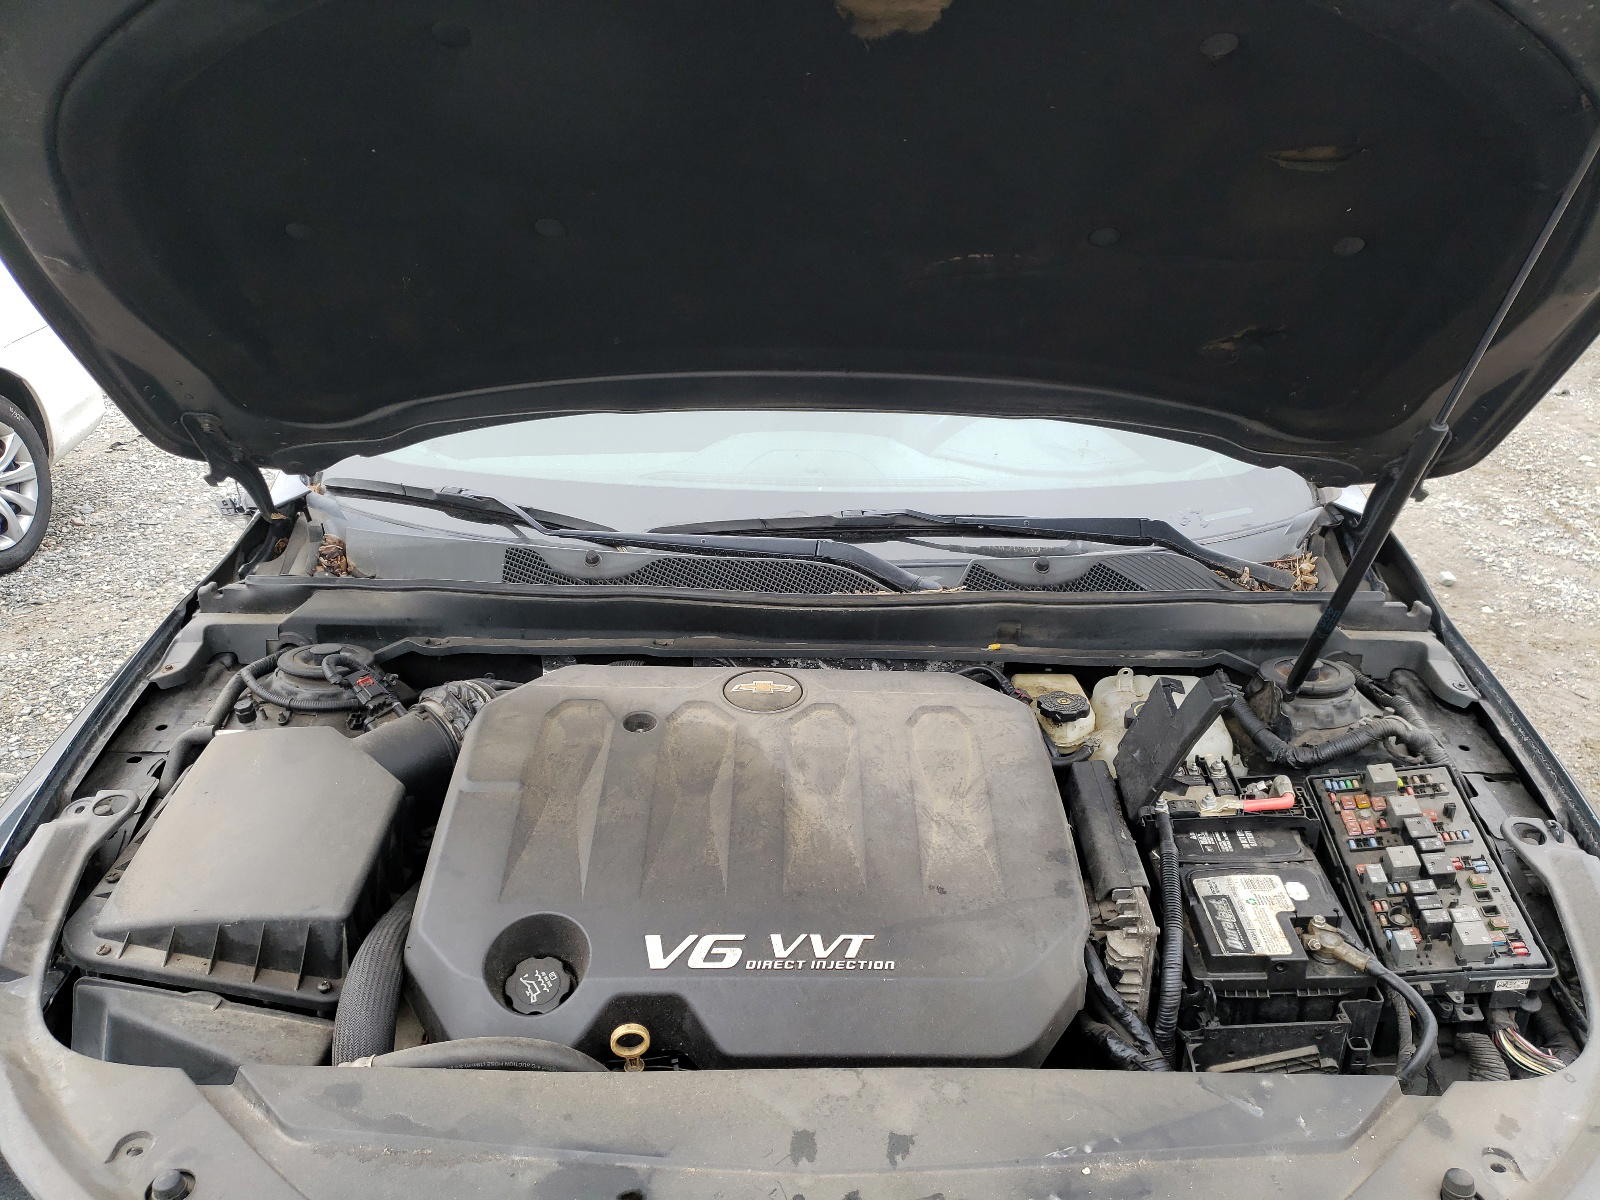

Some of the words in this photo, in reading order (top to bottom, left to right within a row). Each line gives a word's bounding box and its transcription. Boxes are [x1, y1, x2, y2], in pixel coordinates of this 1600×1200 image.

[644, 934, 746, 969] V6
[770, 933, 875, 958] VVT
[745, 960, 806, 970] DIRECT
[810, 960, 895, 970] INJECTION
